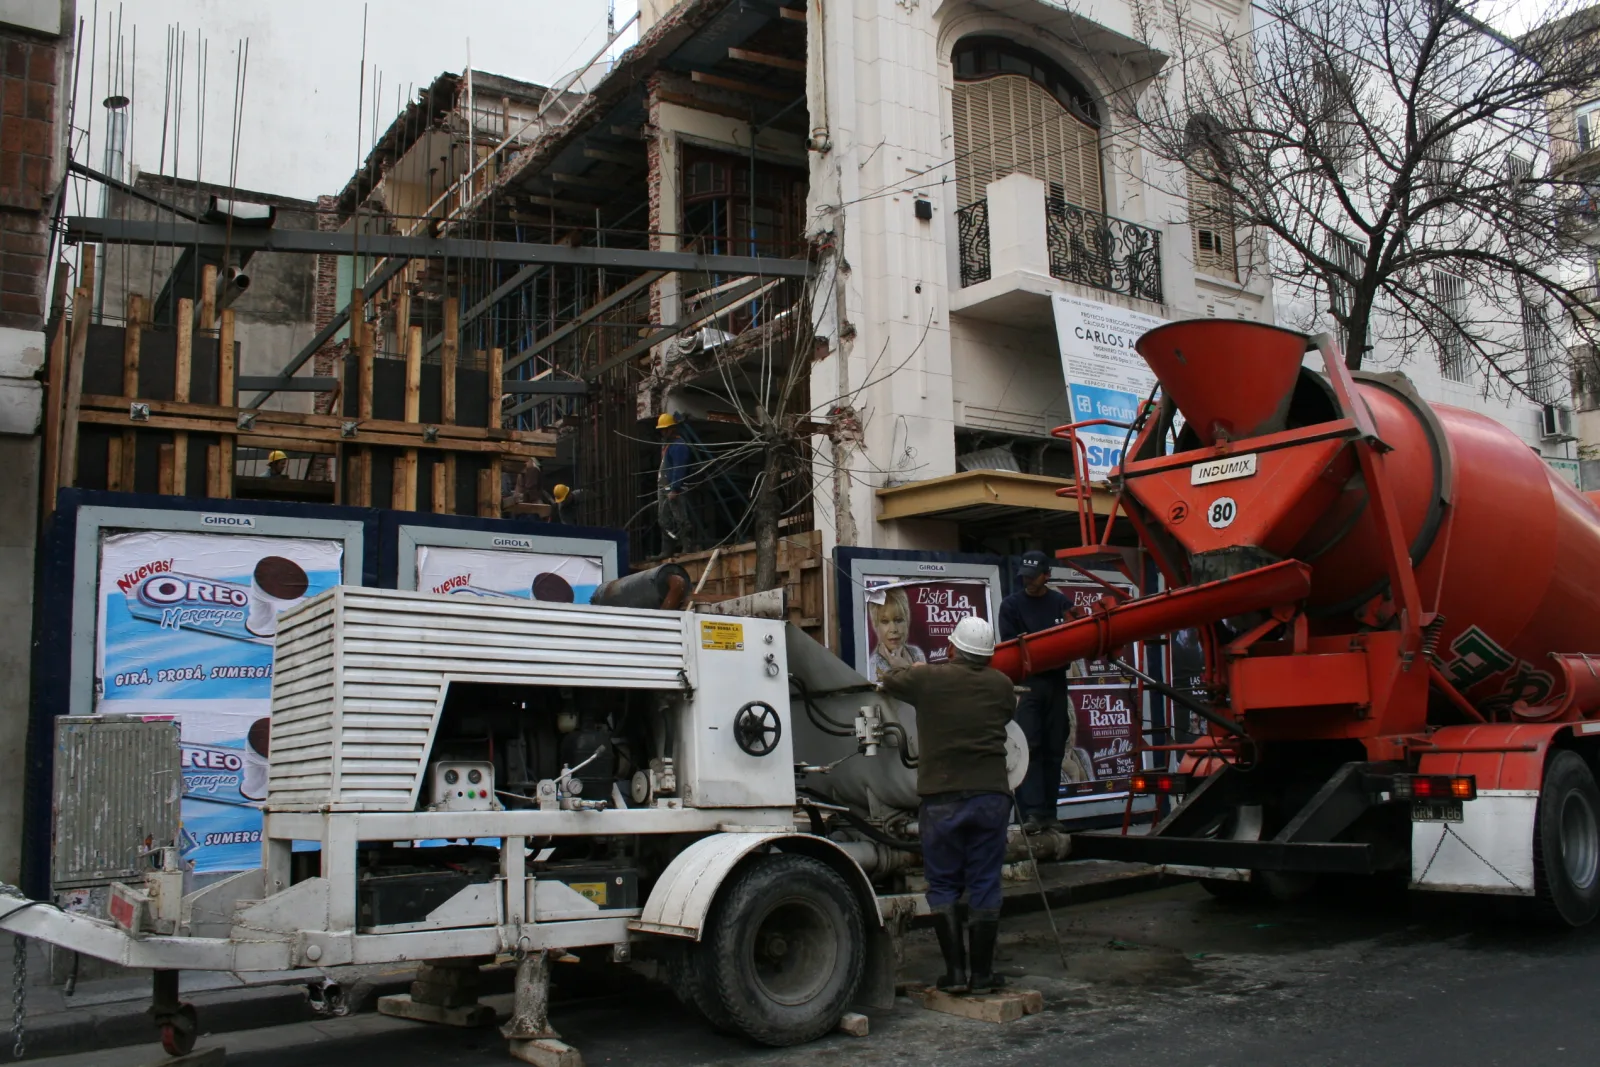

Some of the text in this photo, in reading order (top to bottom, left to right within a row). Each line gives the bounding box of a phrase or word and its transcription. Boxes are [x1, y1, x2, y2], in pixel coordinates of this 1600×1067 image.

[1074, 326, 1124, 348] CARLOS
[1084, 380, 1106, 388] ESPACIO
[1096, 401, 1136, 419] ferrum
[1199, 460, 1250, 478] INDUMIX
[204, 516, 252, 526] GIROLA
[1172, 506, 1184, 520] 2
[1212, 502, 1233, 522] 80
[494, 538, 530, 548] GIROLA
[117, 558, 174, 594] Nuevas!
[144, 576, 248, 607] OREO
[115, 668, 153, 687] GIRÁ,
[158, 665, 206, 683] PROBÁ,
[1089, 708, 1132, 727] Raval
[182, 751, 242, 771] REO
[1116, 757, 1134, 766] Sept.
[1116, 764, 1135, 774] 26-27
[1440, 806, 1461, 820] 186
